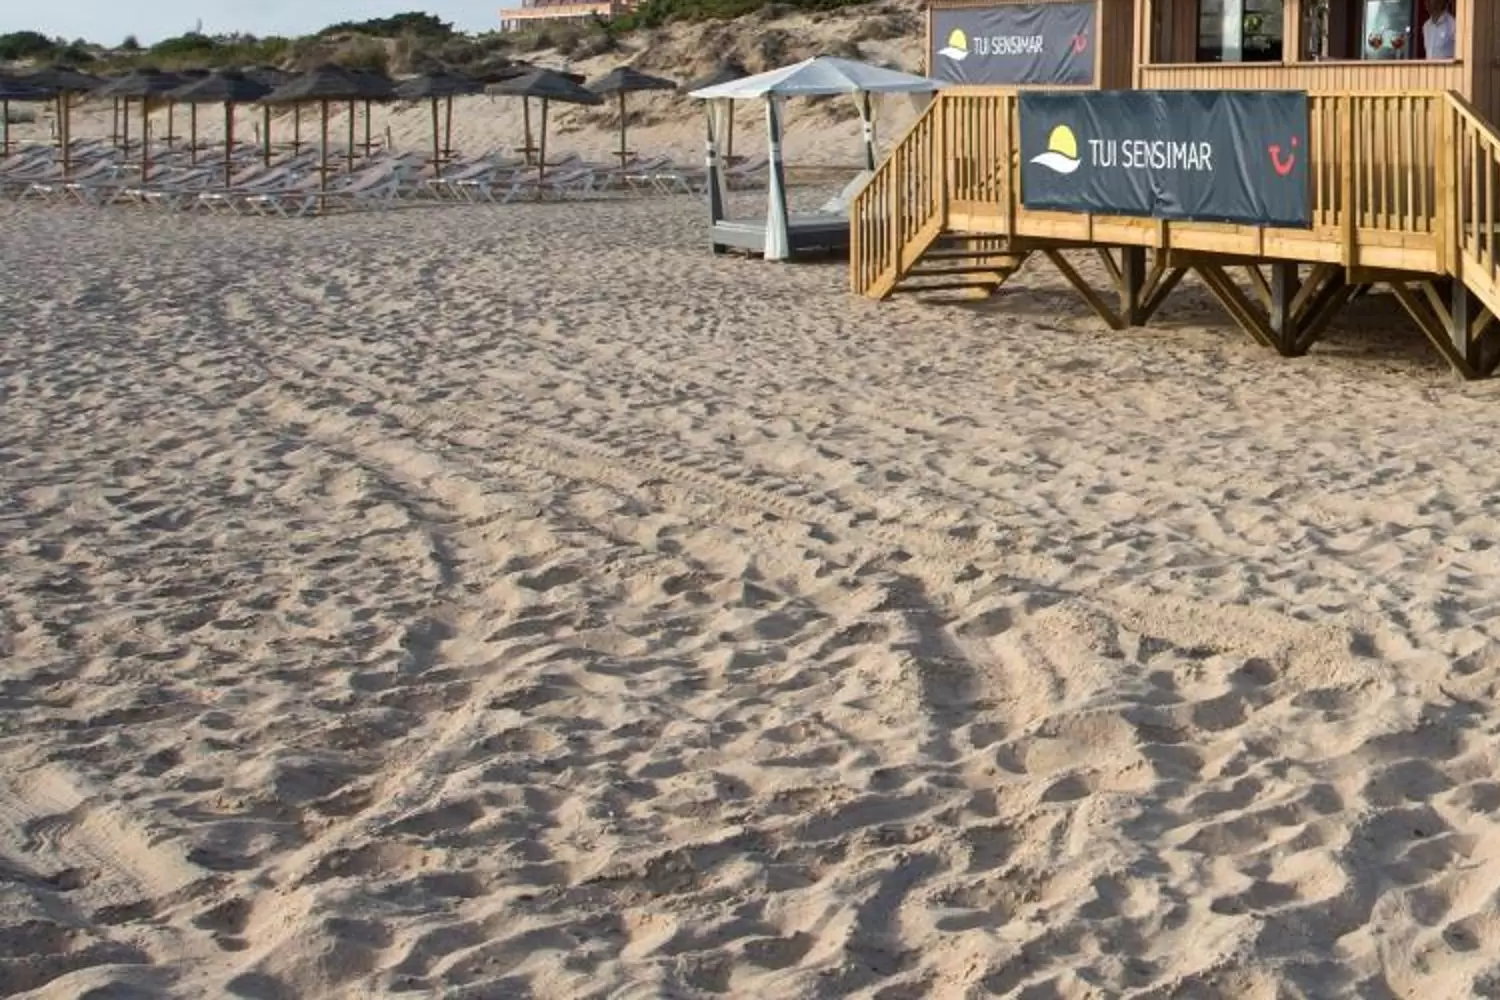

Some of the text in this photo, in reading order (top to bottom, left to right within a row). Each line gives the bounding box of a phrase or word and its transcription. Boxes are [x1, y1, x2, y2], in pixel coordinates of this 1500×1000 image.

[973, 34, 1044, 56] TUI SENSIMAR
[1087, 138, 1213, 171] TUI SENSIMAR
